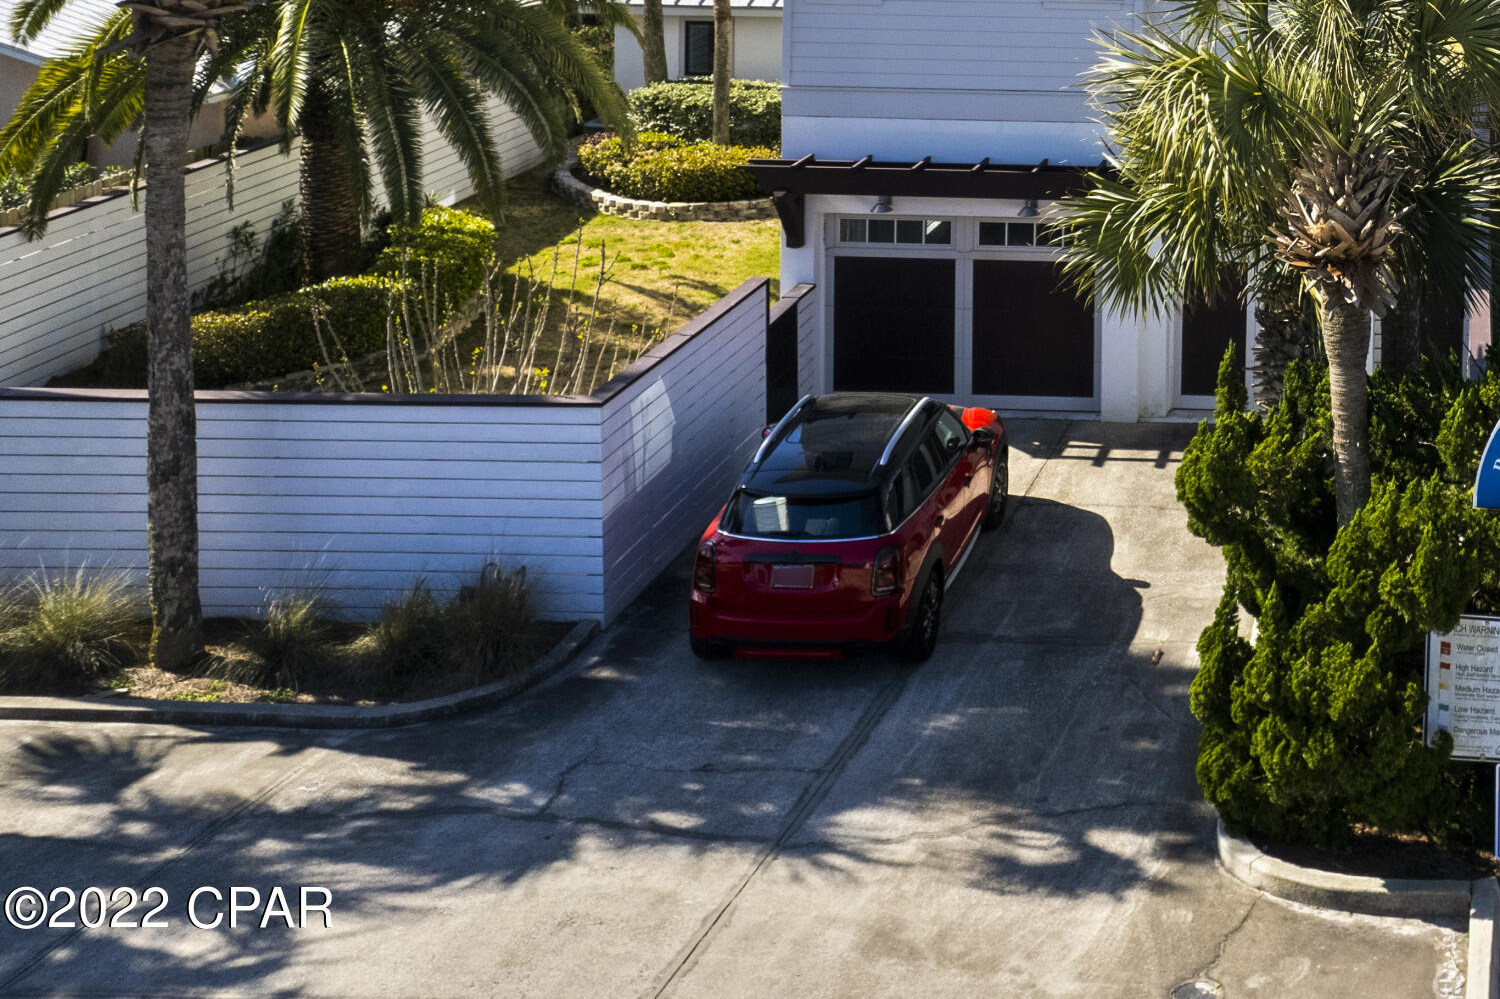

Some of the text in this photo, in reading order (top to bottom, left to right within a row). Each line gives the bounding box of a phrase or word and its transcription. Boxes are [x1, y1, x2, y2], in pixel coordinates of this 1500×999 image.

[1476, 645, 1498, 653] Closed
[1471, 665, 1493, 673] Hazard
[1470, 706, 1495, 714] Hazard
[1453, 726, 1487, 735] Dangerous
